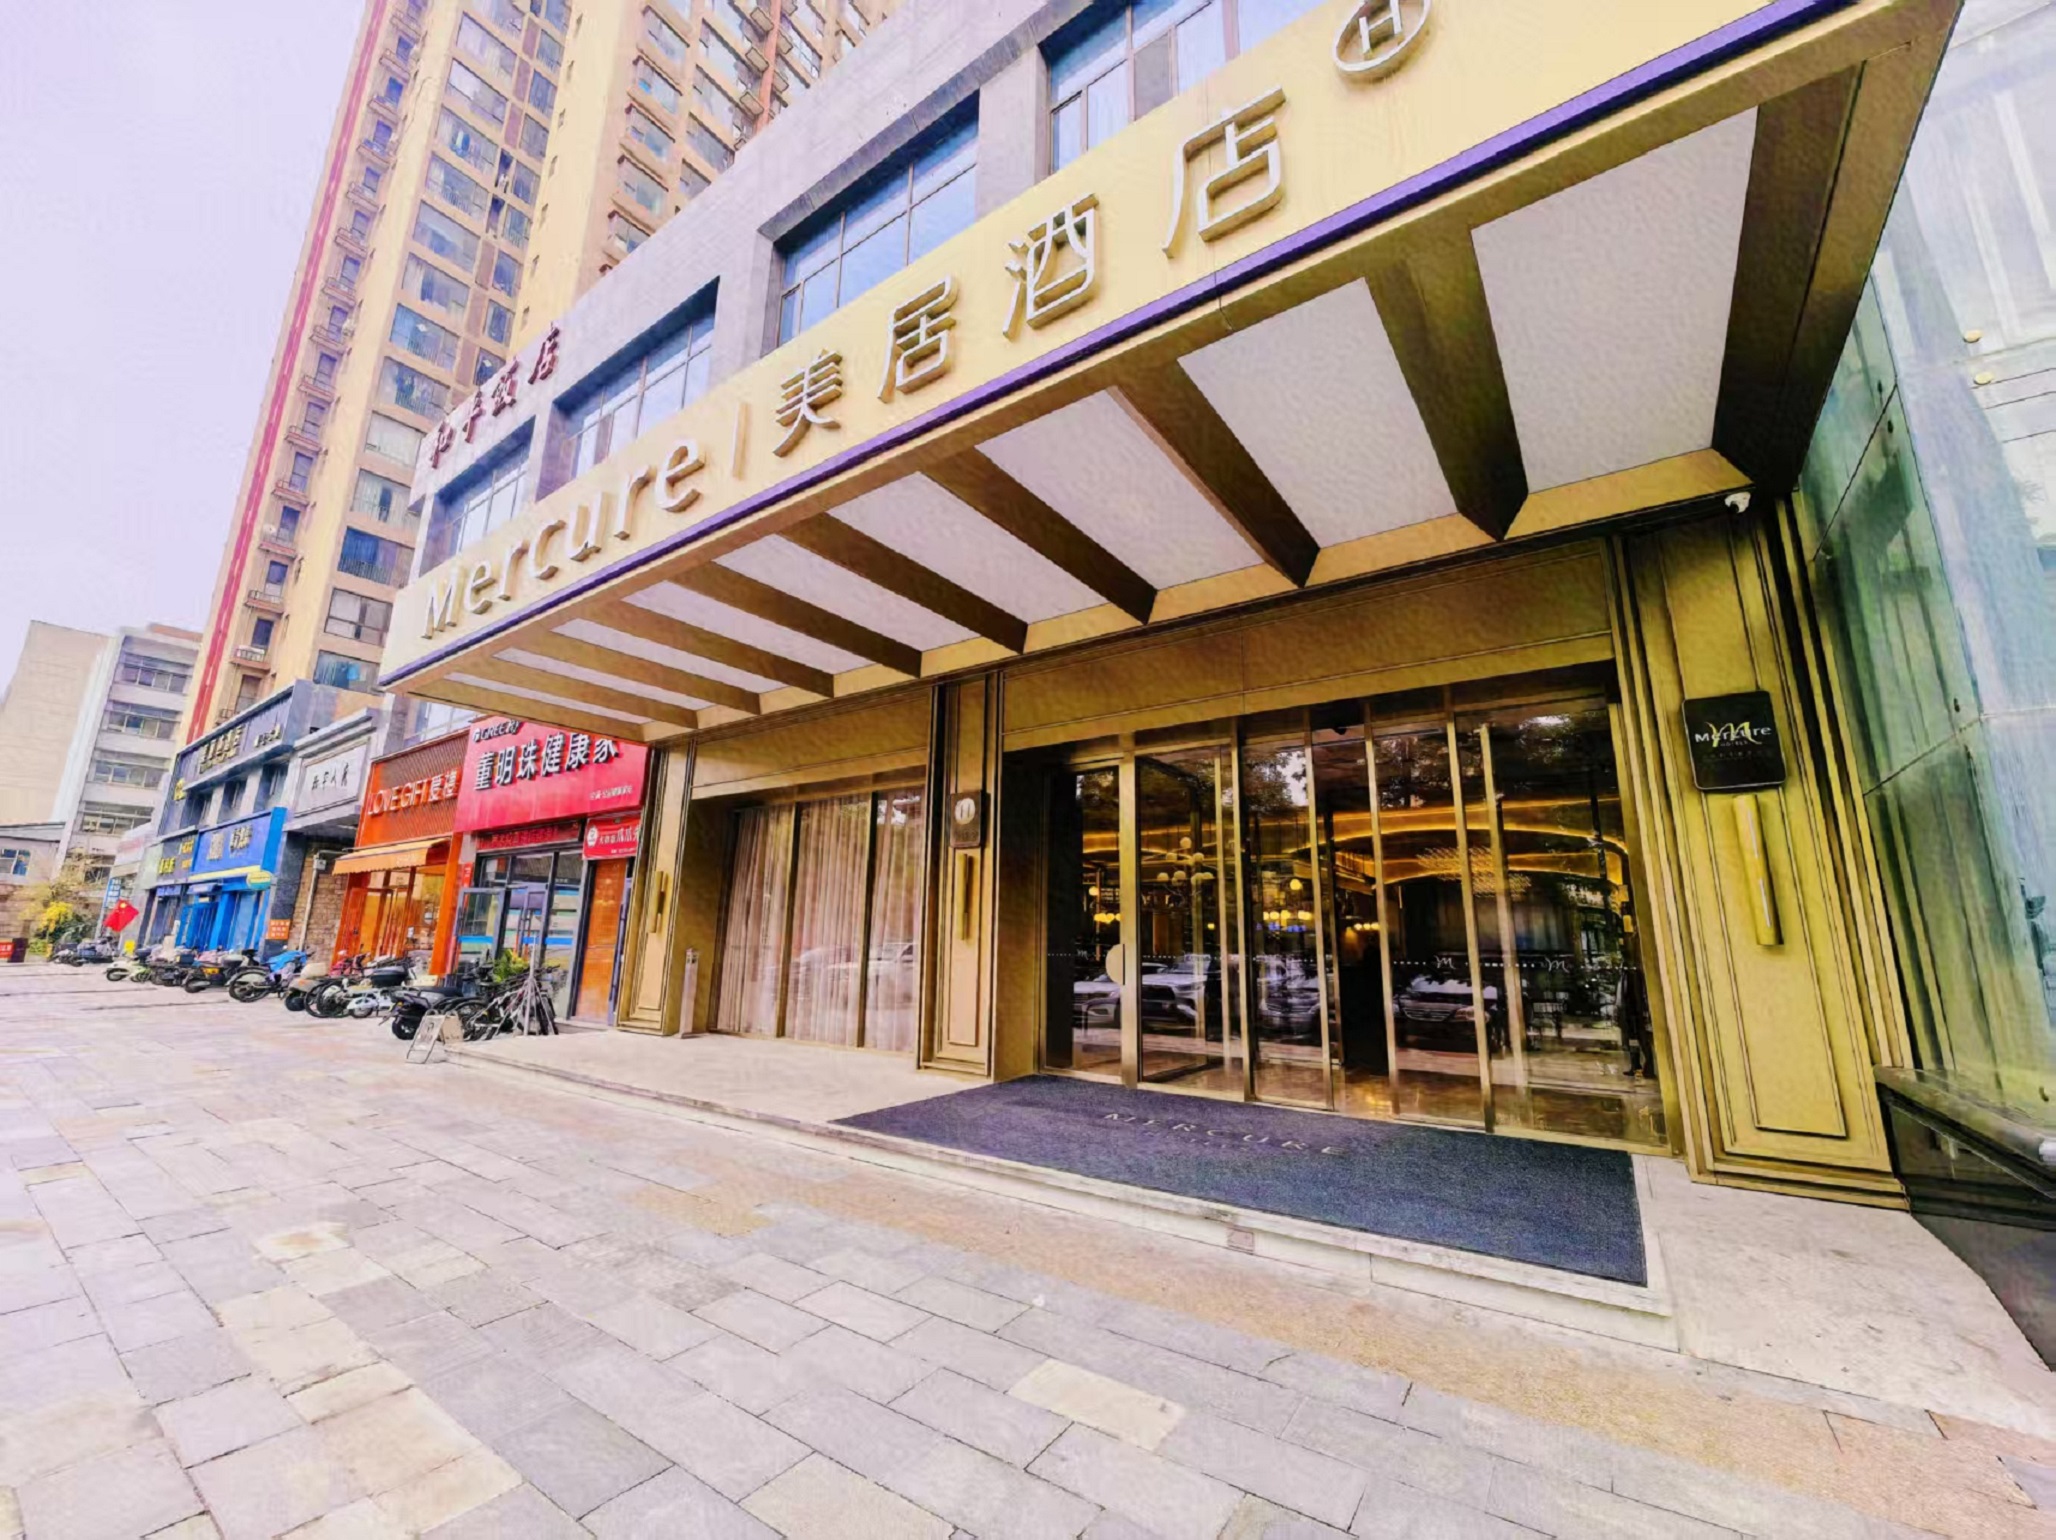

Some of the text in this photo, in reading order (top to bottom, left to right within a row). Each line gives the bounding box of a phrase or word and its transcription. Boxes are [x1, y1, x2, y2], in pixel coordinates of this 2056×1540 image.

[421, 84, 1287, 640] Mercure 美居酒店
